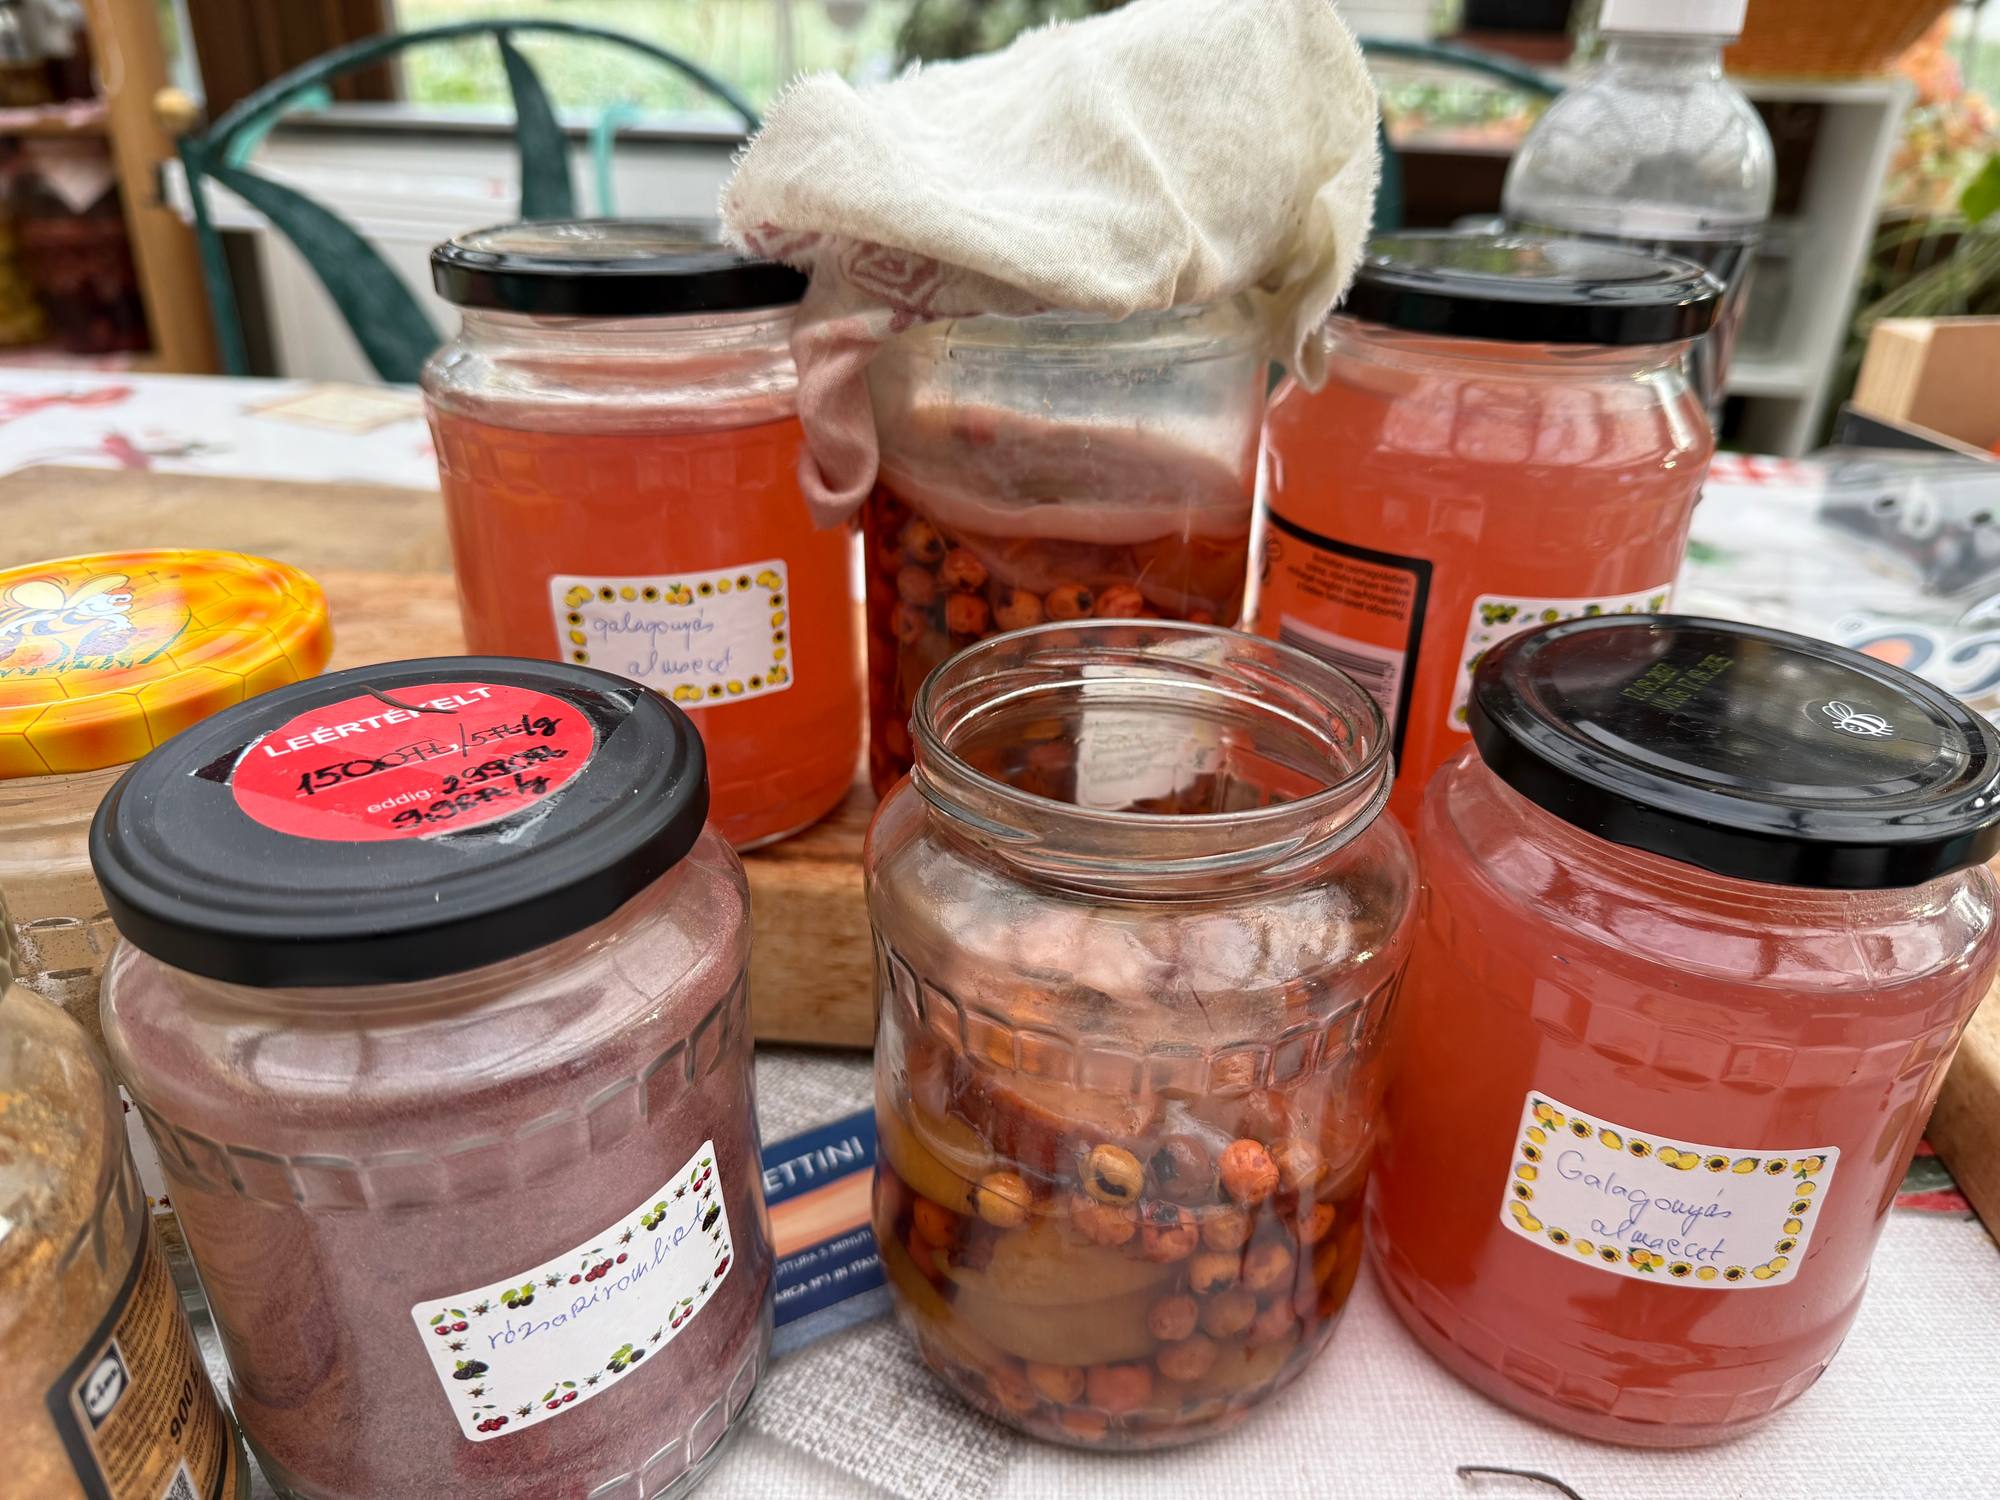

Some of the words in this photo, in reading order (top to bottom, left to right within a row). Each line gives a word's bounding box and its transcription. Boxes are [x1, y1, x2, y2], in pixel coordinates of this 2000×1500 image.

[366, 786, 436, 815] eddig:
[1556, 1149, 1733, 1237] Galagonyás
[170, 1379, 194, 1445] 900
